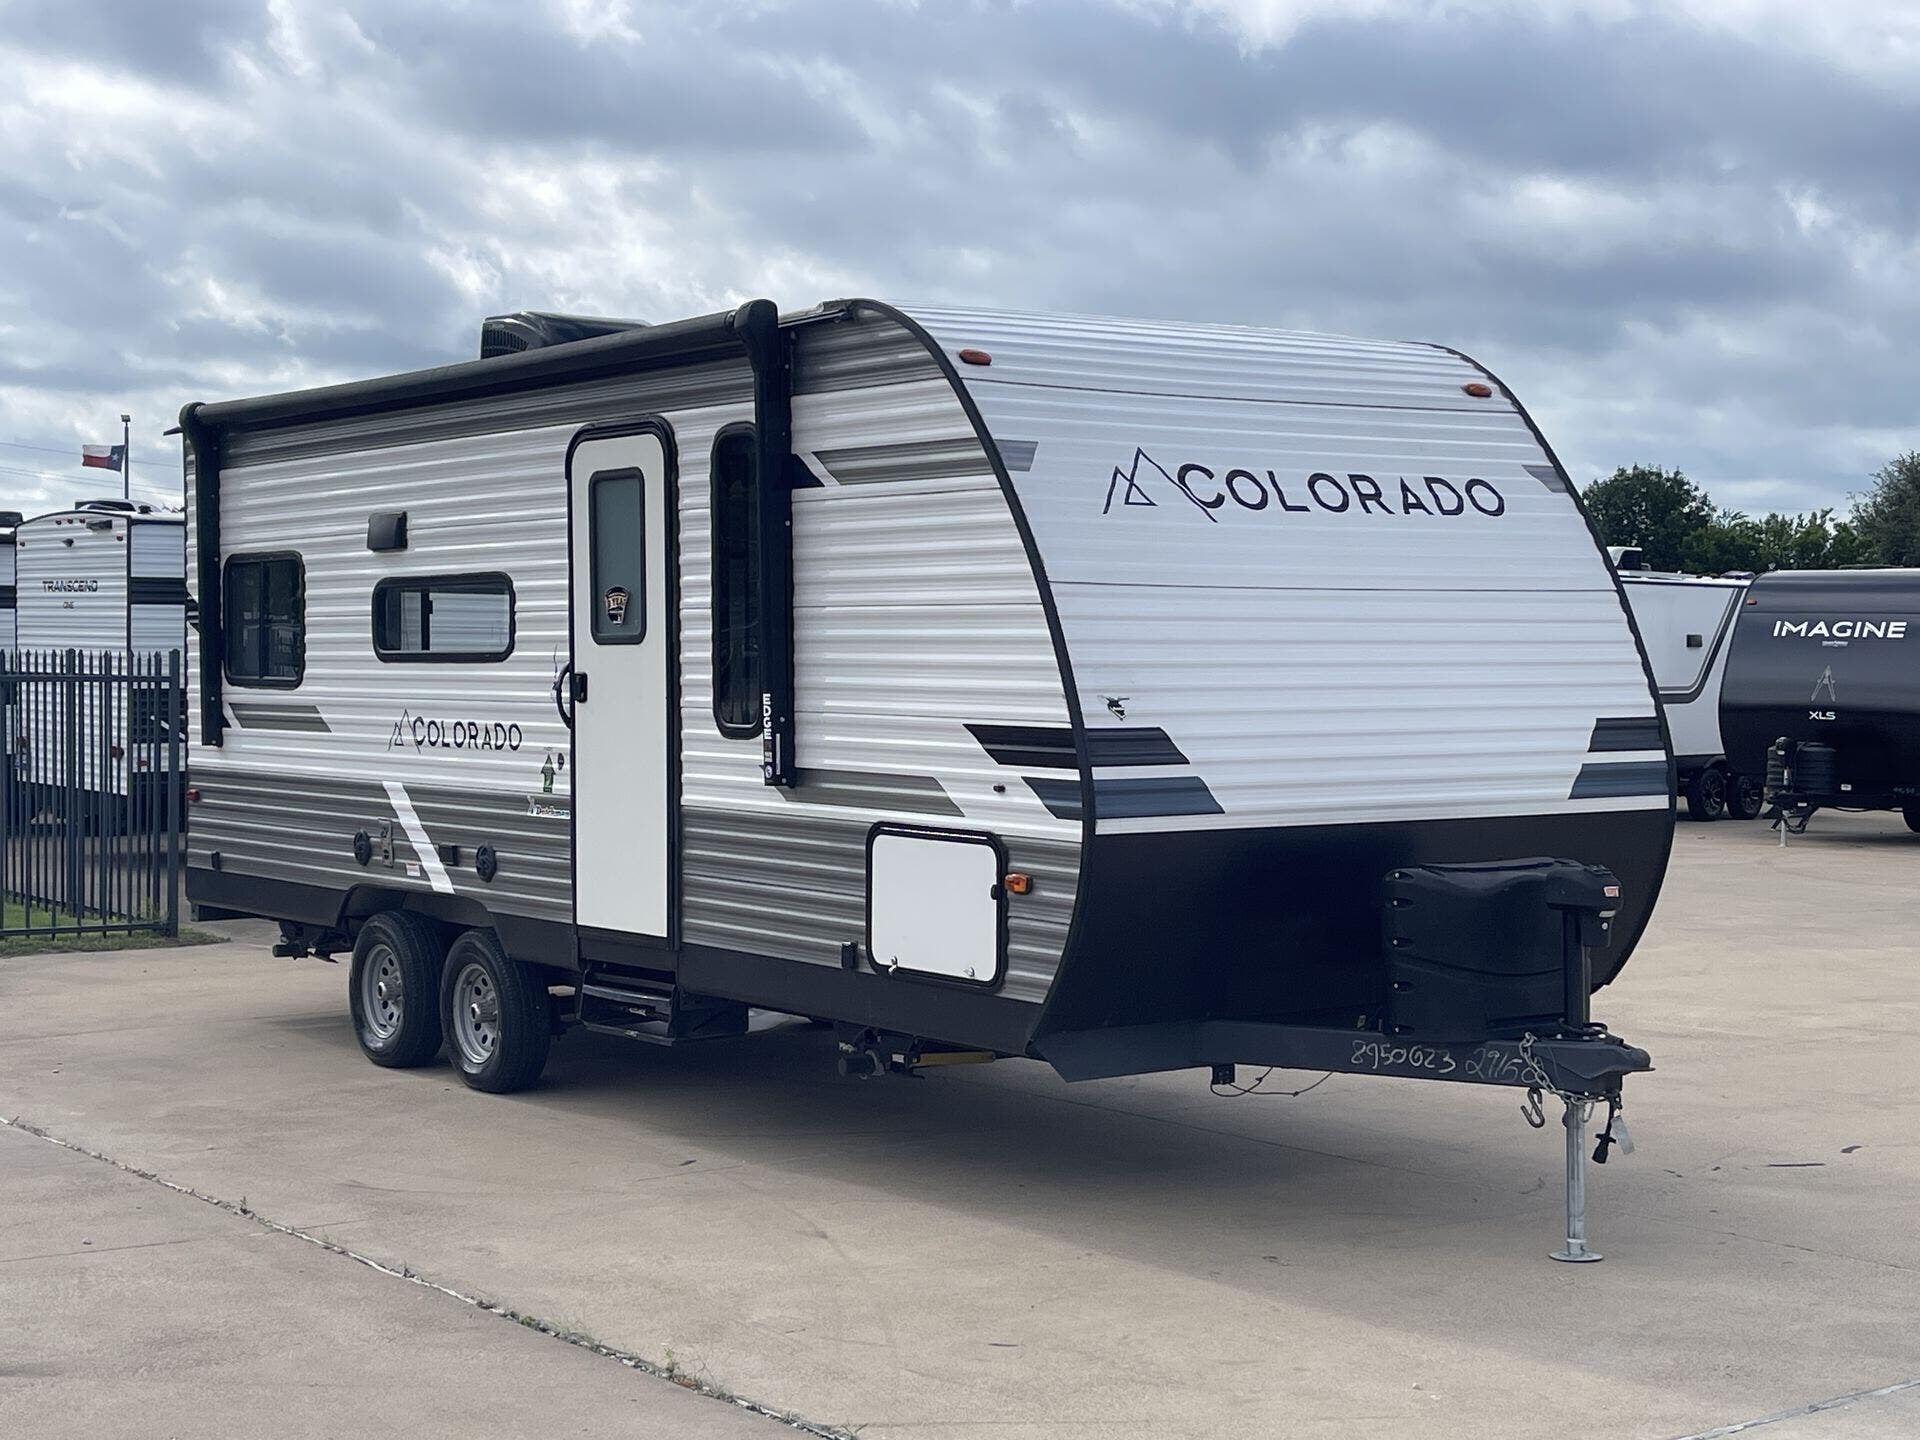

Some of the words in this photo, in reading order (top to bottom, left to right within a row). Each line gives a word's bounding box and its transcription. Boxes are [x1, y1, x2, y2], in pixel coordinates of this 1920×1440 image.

[1177, 463, 1505, 517] COLORADO
[42, 580, 98, 592] TRANSCEND
[1773, 620, 1908, 638] IMAGINE
[762, 693, 773, 740] EDGE
[1808, 711, 1836, 720] XLS
[413, 716, 523, 751] COLORADO
